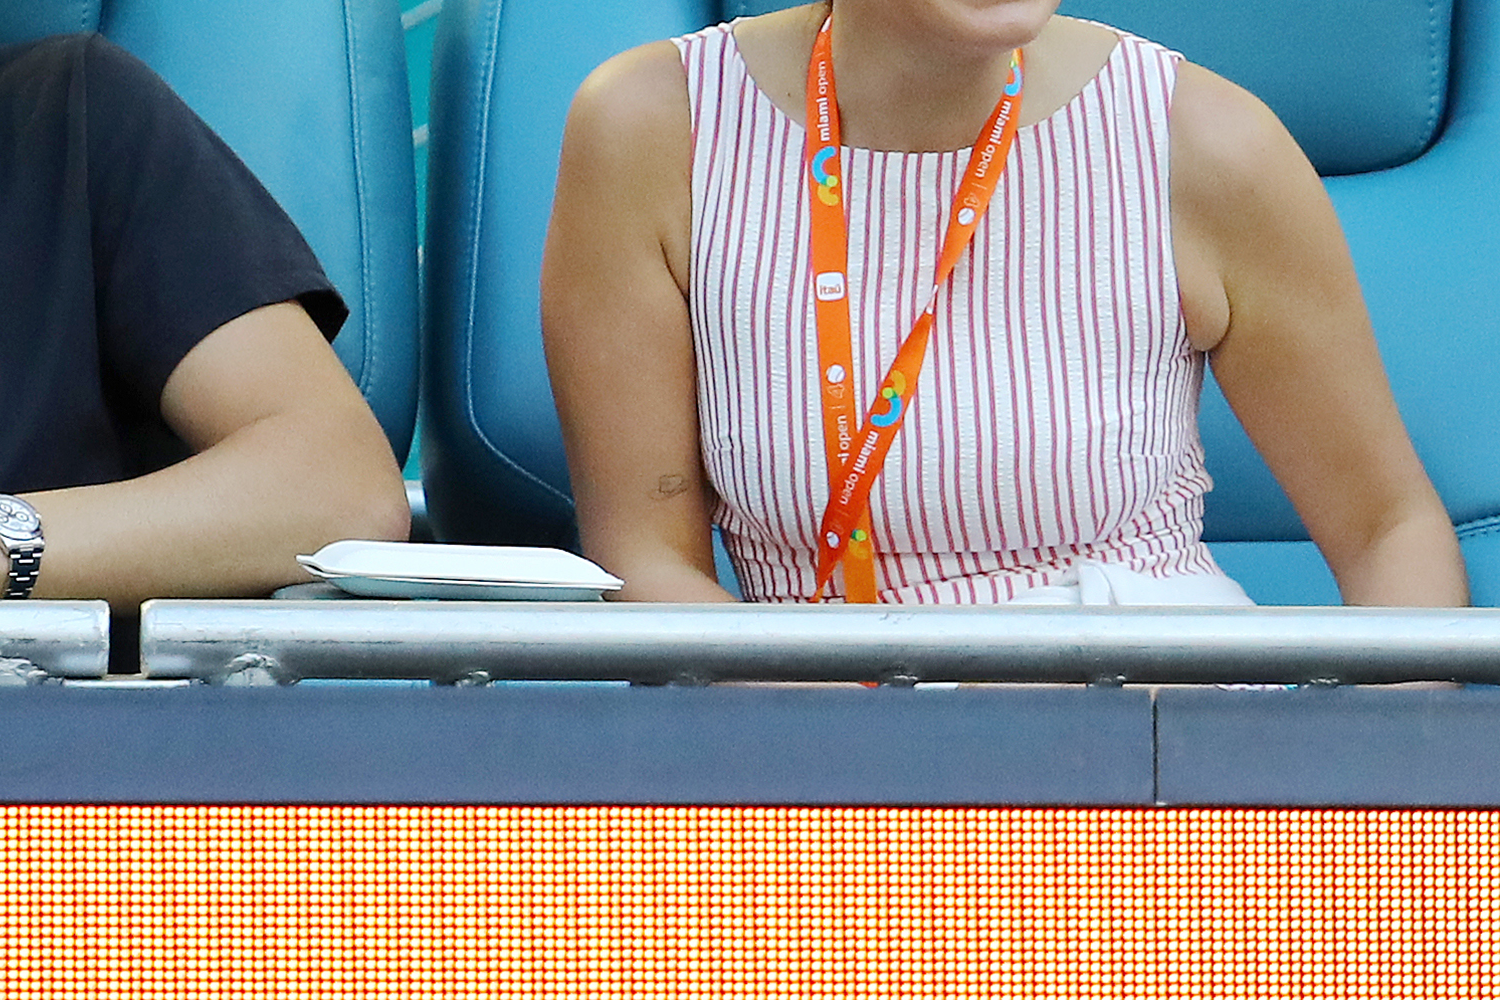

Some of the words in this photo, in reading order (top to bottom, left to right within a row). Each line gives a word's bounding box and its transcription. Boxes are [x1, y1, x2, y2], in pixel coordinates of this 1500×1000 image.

[817, 61, 830, 95] open
[816, 97, 830, 141] miami
[988, 100, 1012, 144] miami
[975, 144, 995, 179] open
[837, 415, 852, 450] open
[853, 431, 879, 474] miami
[839, 473, 859, 505] open
